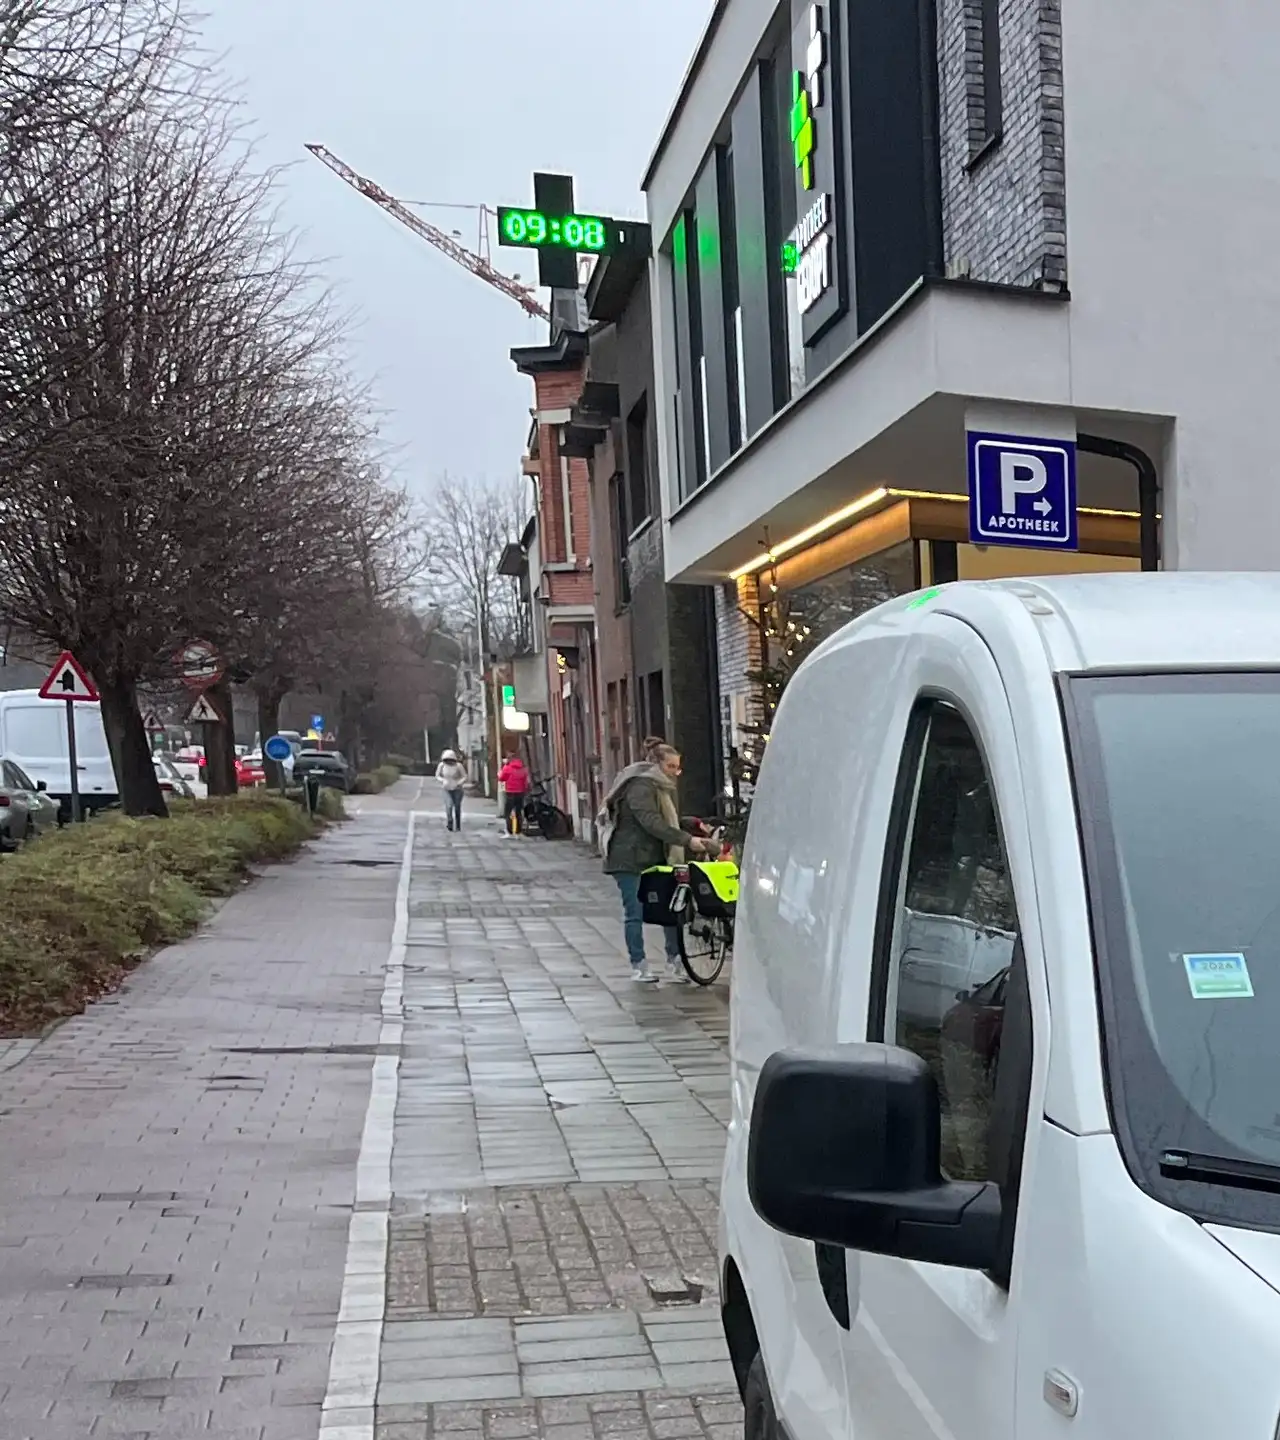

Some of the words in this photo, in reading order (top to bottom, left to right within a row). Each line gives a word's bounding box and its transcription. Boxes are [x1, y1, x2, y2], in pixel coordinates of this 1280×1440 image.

[505, 212, 605, 250] 09:08
[1000, 452, 1047, 514] P
[988, 515, 1060, 533] APOTHEEK
